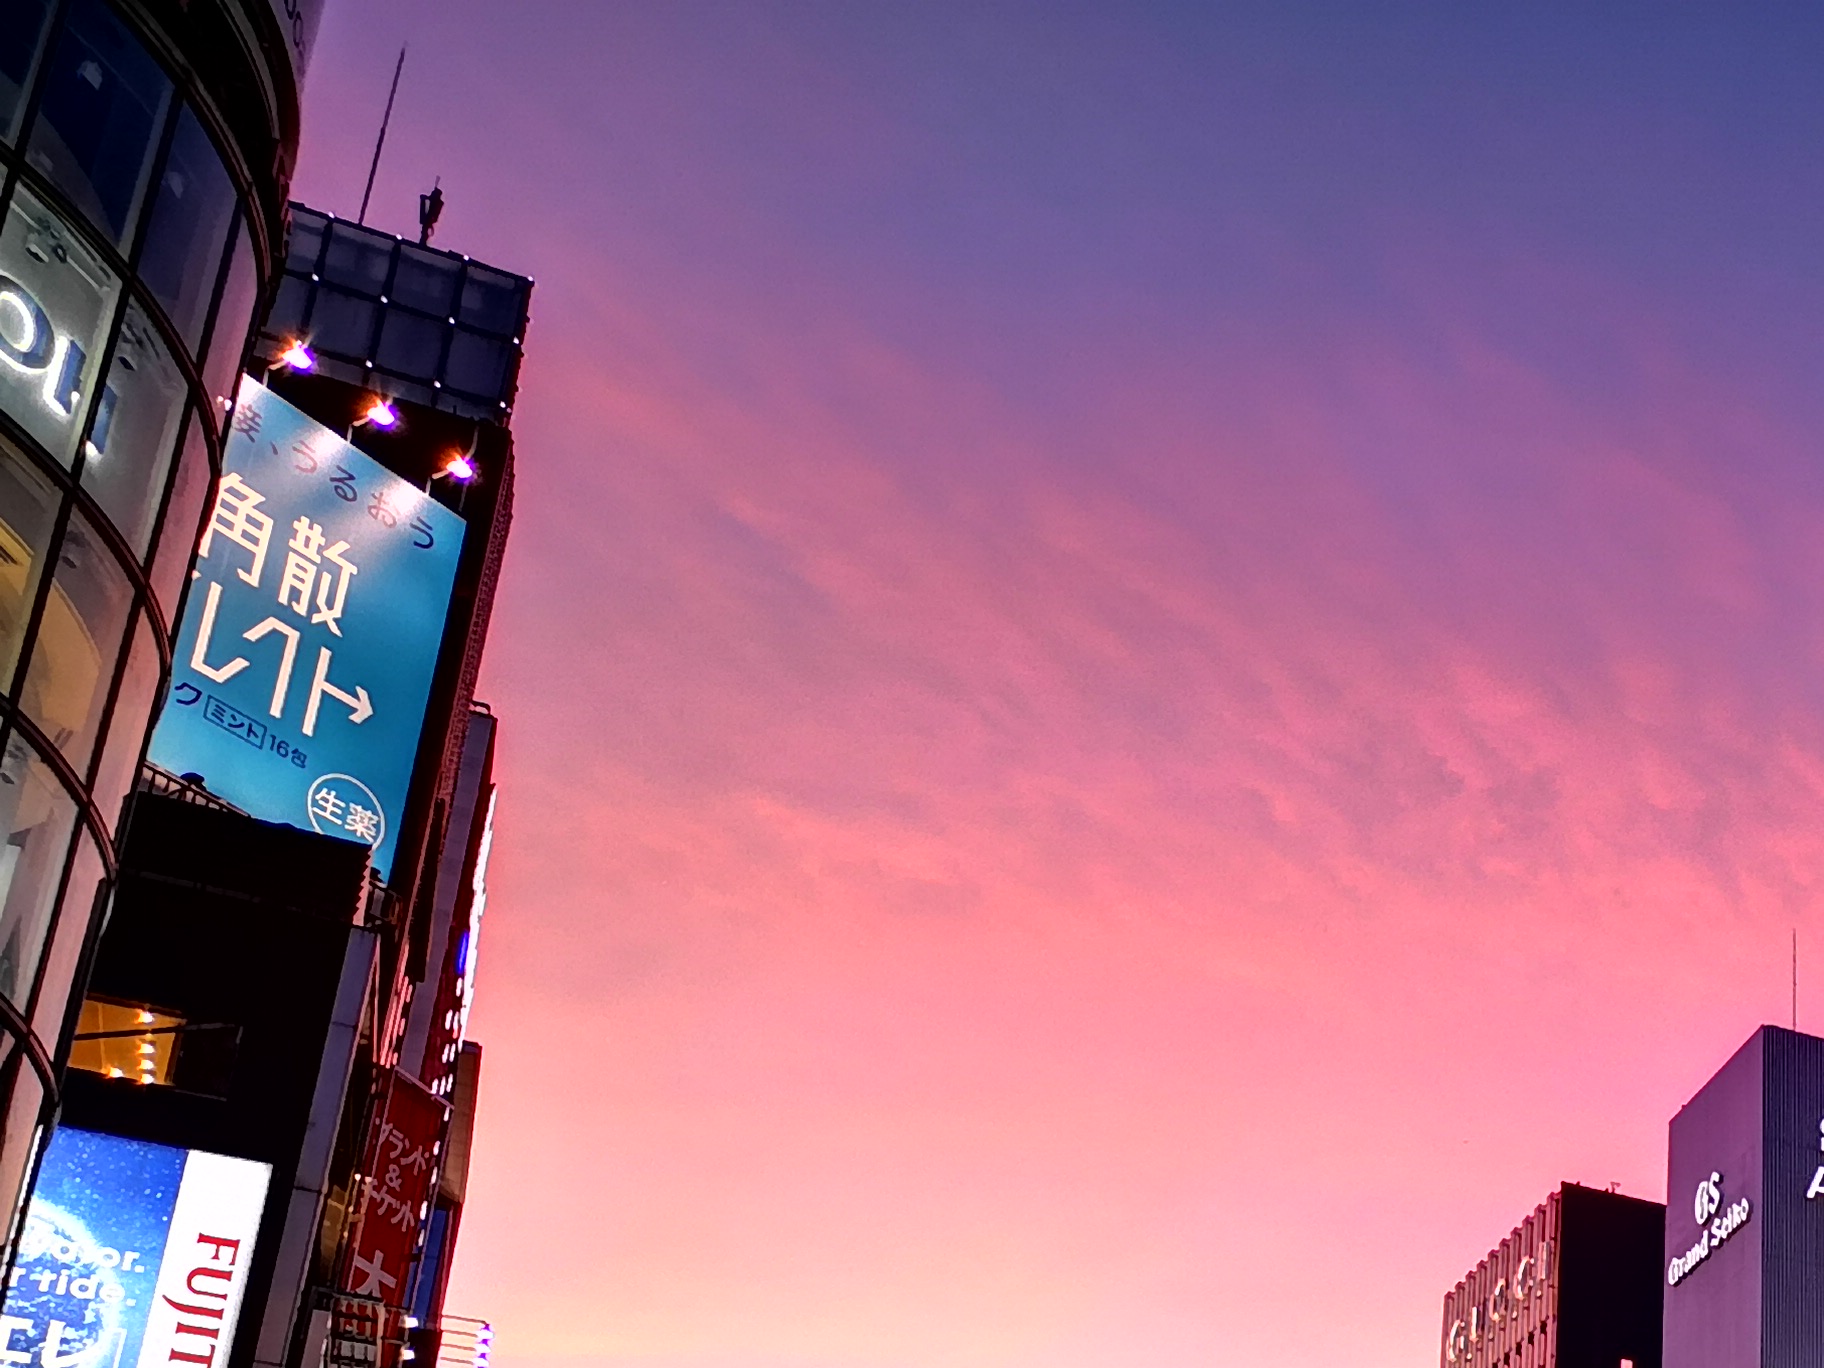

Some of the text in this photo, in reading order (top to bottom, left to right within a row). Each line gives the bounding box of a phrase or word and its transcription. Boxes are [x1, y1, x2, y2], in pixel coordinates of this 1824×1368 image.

[198, 472, 358, 638] 角散
[190, 571, 373, 737] レクト
[208, 702, 262, 741] ミント
[269, 733, 308, 768] 16包
[313, 787, 379, 843] 生薬
[386, 1163, 402, 1190] &
[1667, 1197, 1750, 1285] Grand Seiko
